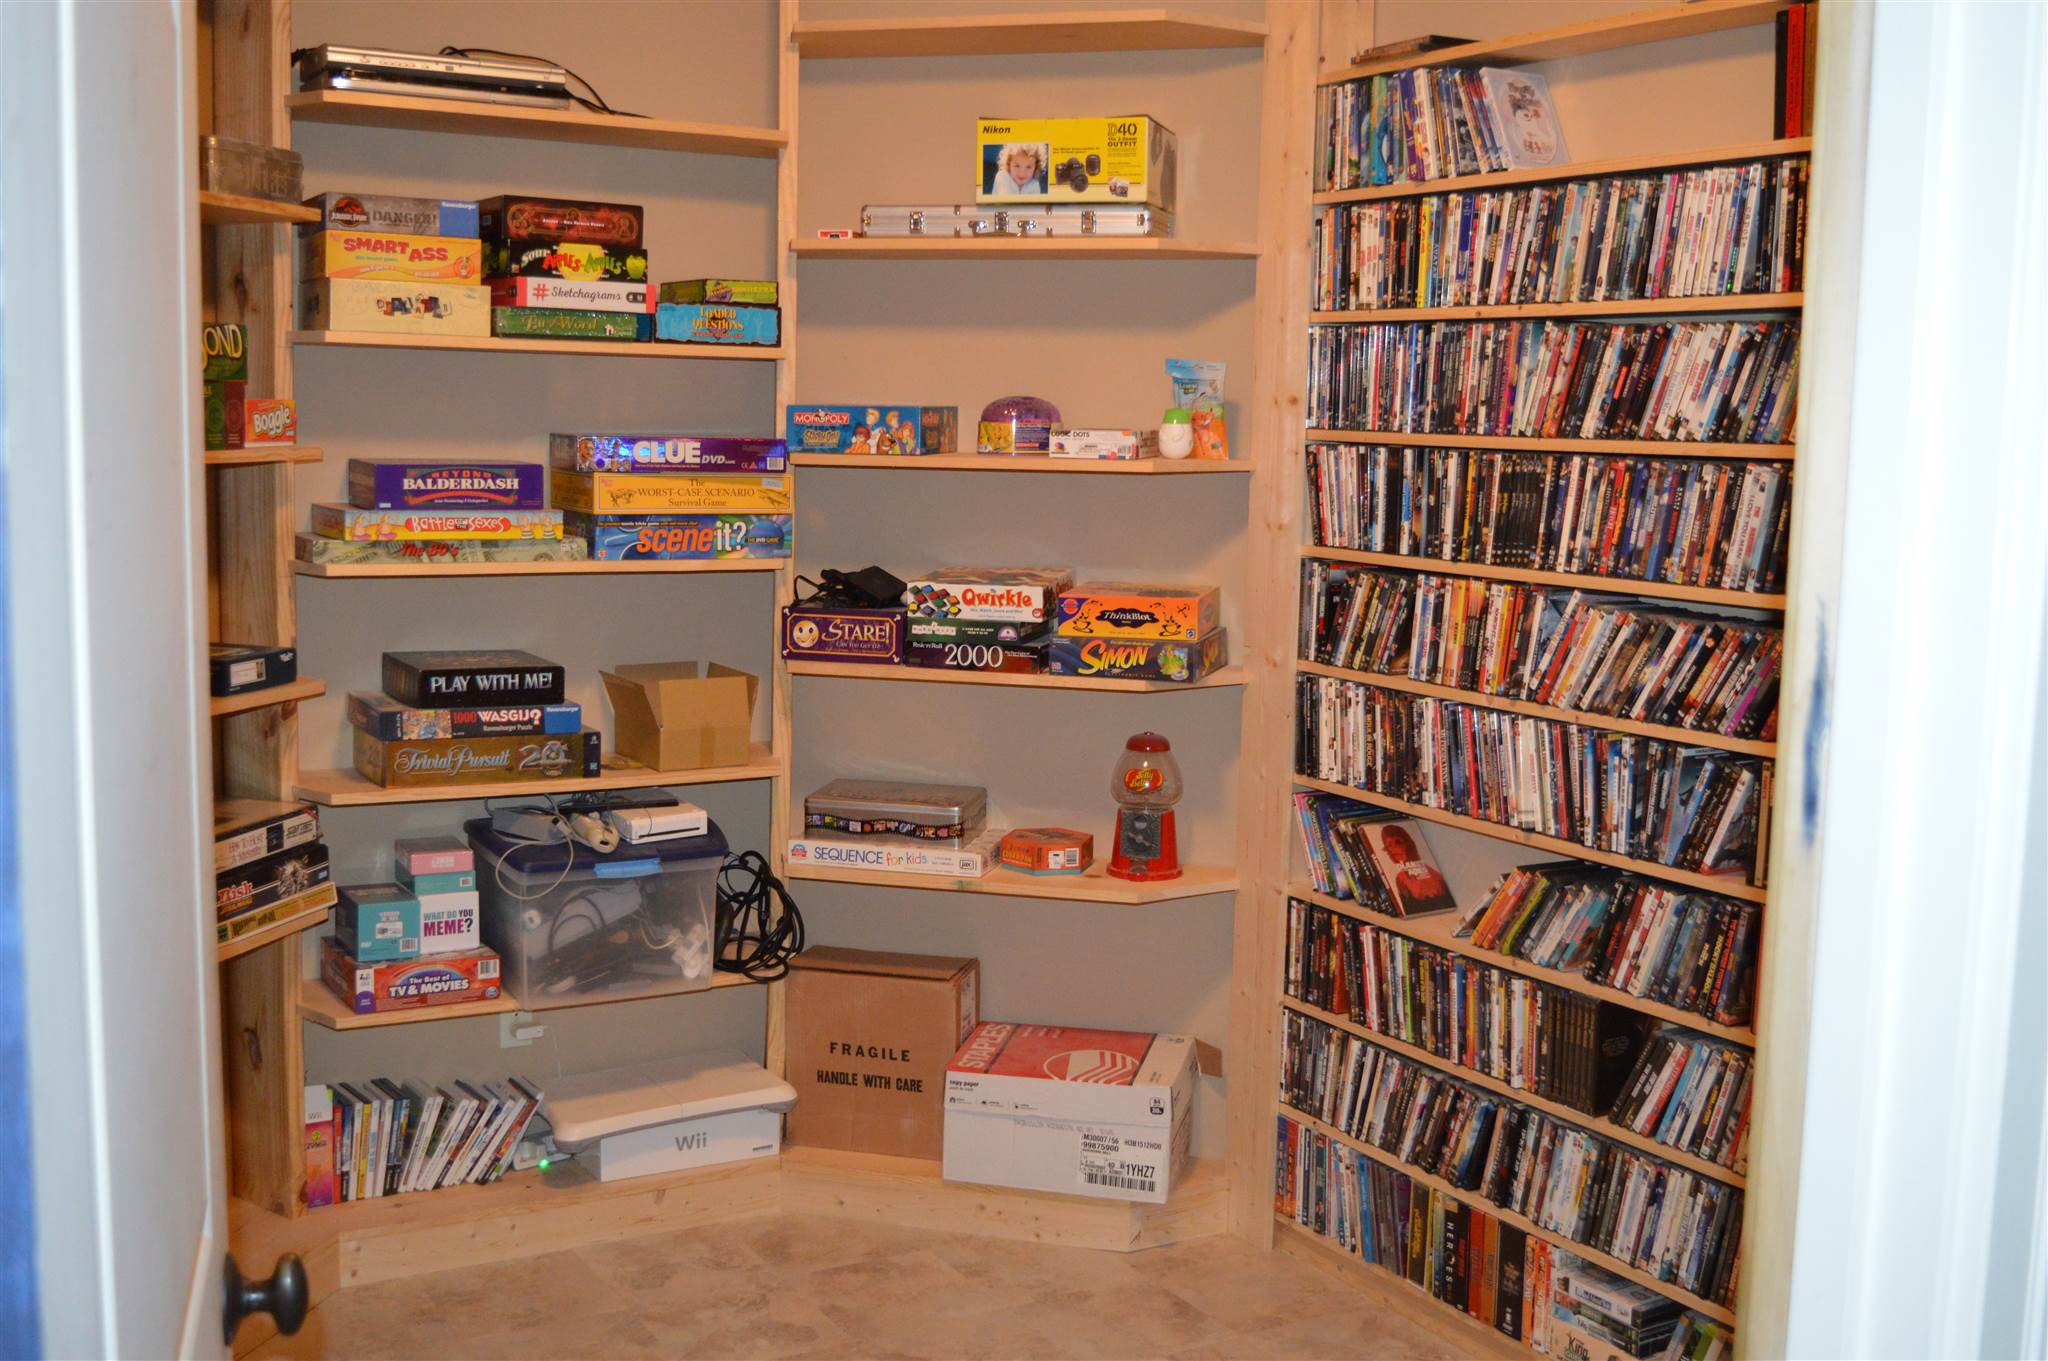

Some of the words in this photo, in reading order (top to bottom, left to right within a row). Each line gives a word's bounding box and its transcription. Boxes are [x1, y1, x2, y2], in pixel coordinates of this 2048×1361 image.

[982, 125, 1011, 134] Nikon
[1107, 122, 1138, 136] D40
[373, 210, 437, 226] DANGER!
[1790, 197, 1806, 259] CELLULAR
[343, 237, 409, 255] SMART
[408, 247, 448, 263] ASS
[521, 248, 550, 266] Sour
[1430, 242, 1440, 278] AVATAR
[700, 307, 737, 319] LOADED
[692, 318, 744, 331] QUESTIONS
[252, 403, 291, 436] Boggle
[794, 413, 850, 424] MONOPOLY
[633, 441, 701, 464] CLUE
[701, 455, 726, 465] DVD
[431, 469, 493, 479] BEYOND
[688, 478, 705, 488] The
[402, 478, 520, 491] BALDERDASH
[704, 488, 755, 497] SCENARIO
[668, 498, 701, 507] Survival
[702, 498, 727, 507] Game
[411, 515, 455, 533] Battle
[467, 515, 505, 533] Sexes
[636, 526, 714, 553] scene
[714, 520, 747, 551] it?
[401, 543, 425, 558] The
[962, 588, 1032, 608] Qwirkle
[1104, 610, 1152, 621] ThinkBlot
[822, 618, 890, 645] STARE!
[944, 644, 1004, 668] 2000
[1078, 639, 1149, 675] SIMON
[430, 675, 471, 694] PLAY
[475, 674, 520, 692] WITH
[523, 672, 553, 689] ME!
[453, 711, 477, 723] 1000
[478, 709, 542, 726] WASGIJ?
[394, 745, 452, 774] Trivial
[449, 744, 511, 776] Pursuit
[814, 846, 884, 864] SEQUENCE
[886, 852, 904, 867] for
[906, 850, 928, 865] kids
[217, 880, 254, 900] Risk
[423, 911, 445, 921] WHAT
[458, 909, 474, 918] YOU
[423, 918, 473, 937] MEME?
[1710, 934, 1724, 960] ROCKY
[409, 976, 423, 984] The
[424, 974, 441, 983] Best
[442, 974, 451, 982] of
[1701, 960, 1717, 993] BALBOA
[389, 986, 406, 998] TV
[407, 985, 418, 995] &
[418, 978, 470, 995] MOVIES
[1534, 989, 1542, 1026] SPLICE
[830, 1042, 910, 1062] FRAGILE
[957, 1023, 1012, 1070] STAPLES
[816, 1070, 858, 1086] HANDLE
[863, 1074, 891, 1090] WITH
[896, 1078, 924, 1093] CARE
[308, 1112, 323, 1120] Wii
[674, 1132, 708, 1152] Wii
[1126, 1163, 1156, 1179] 1YHZ7
[1445, 1219, 1454, 1285] HEROES
